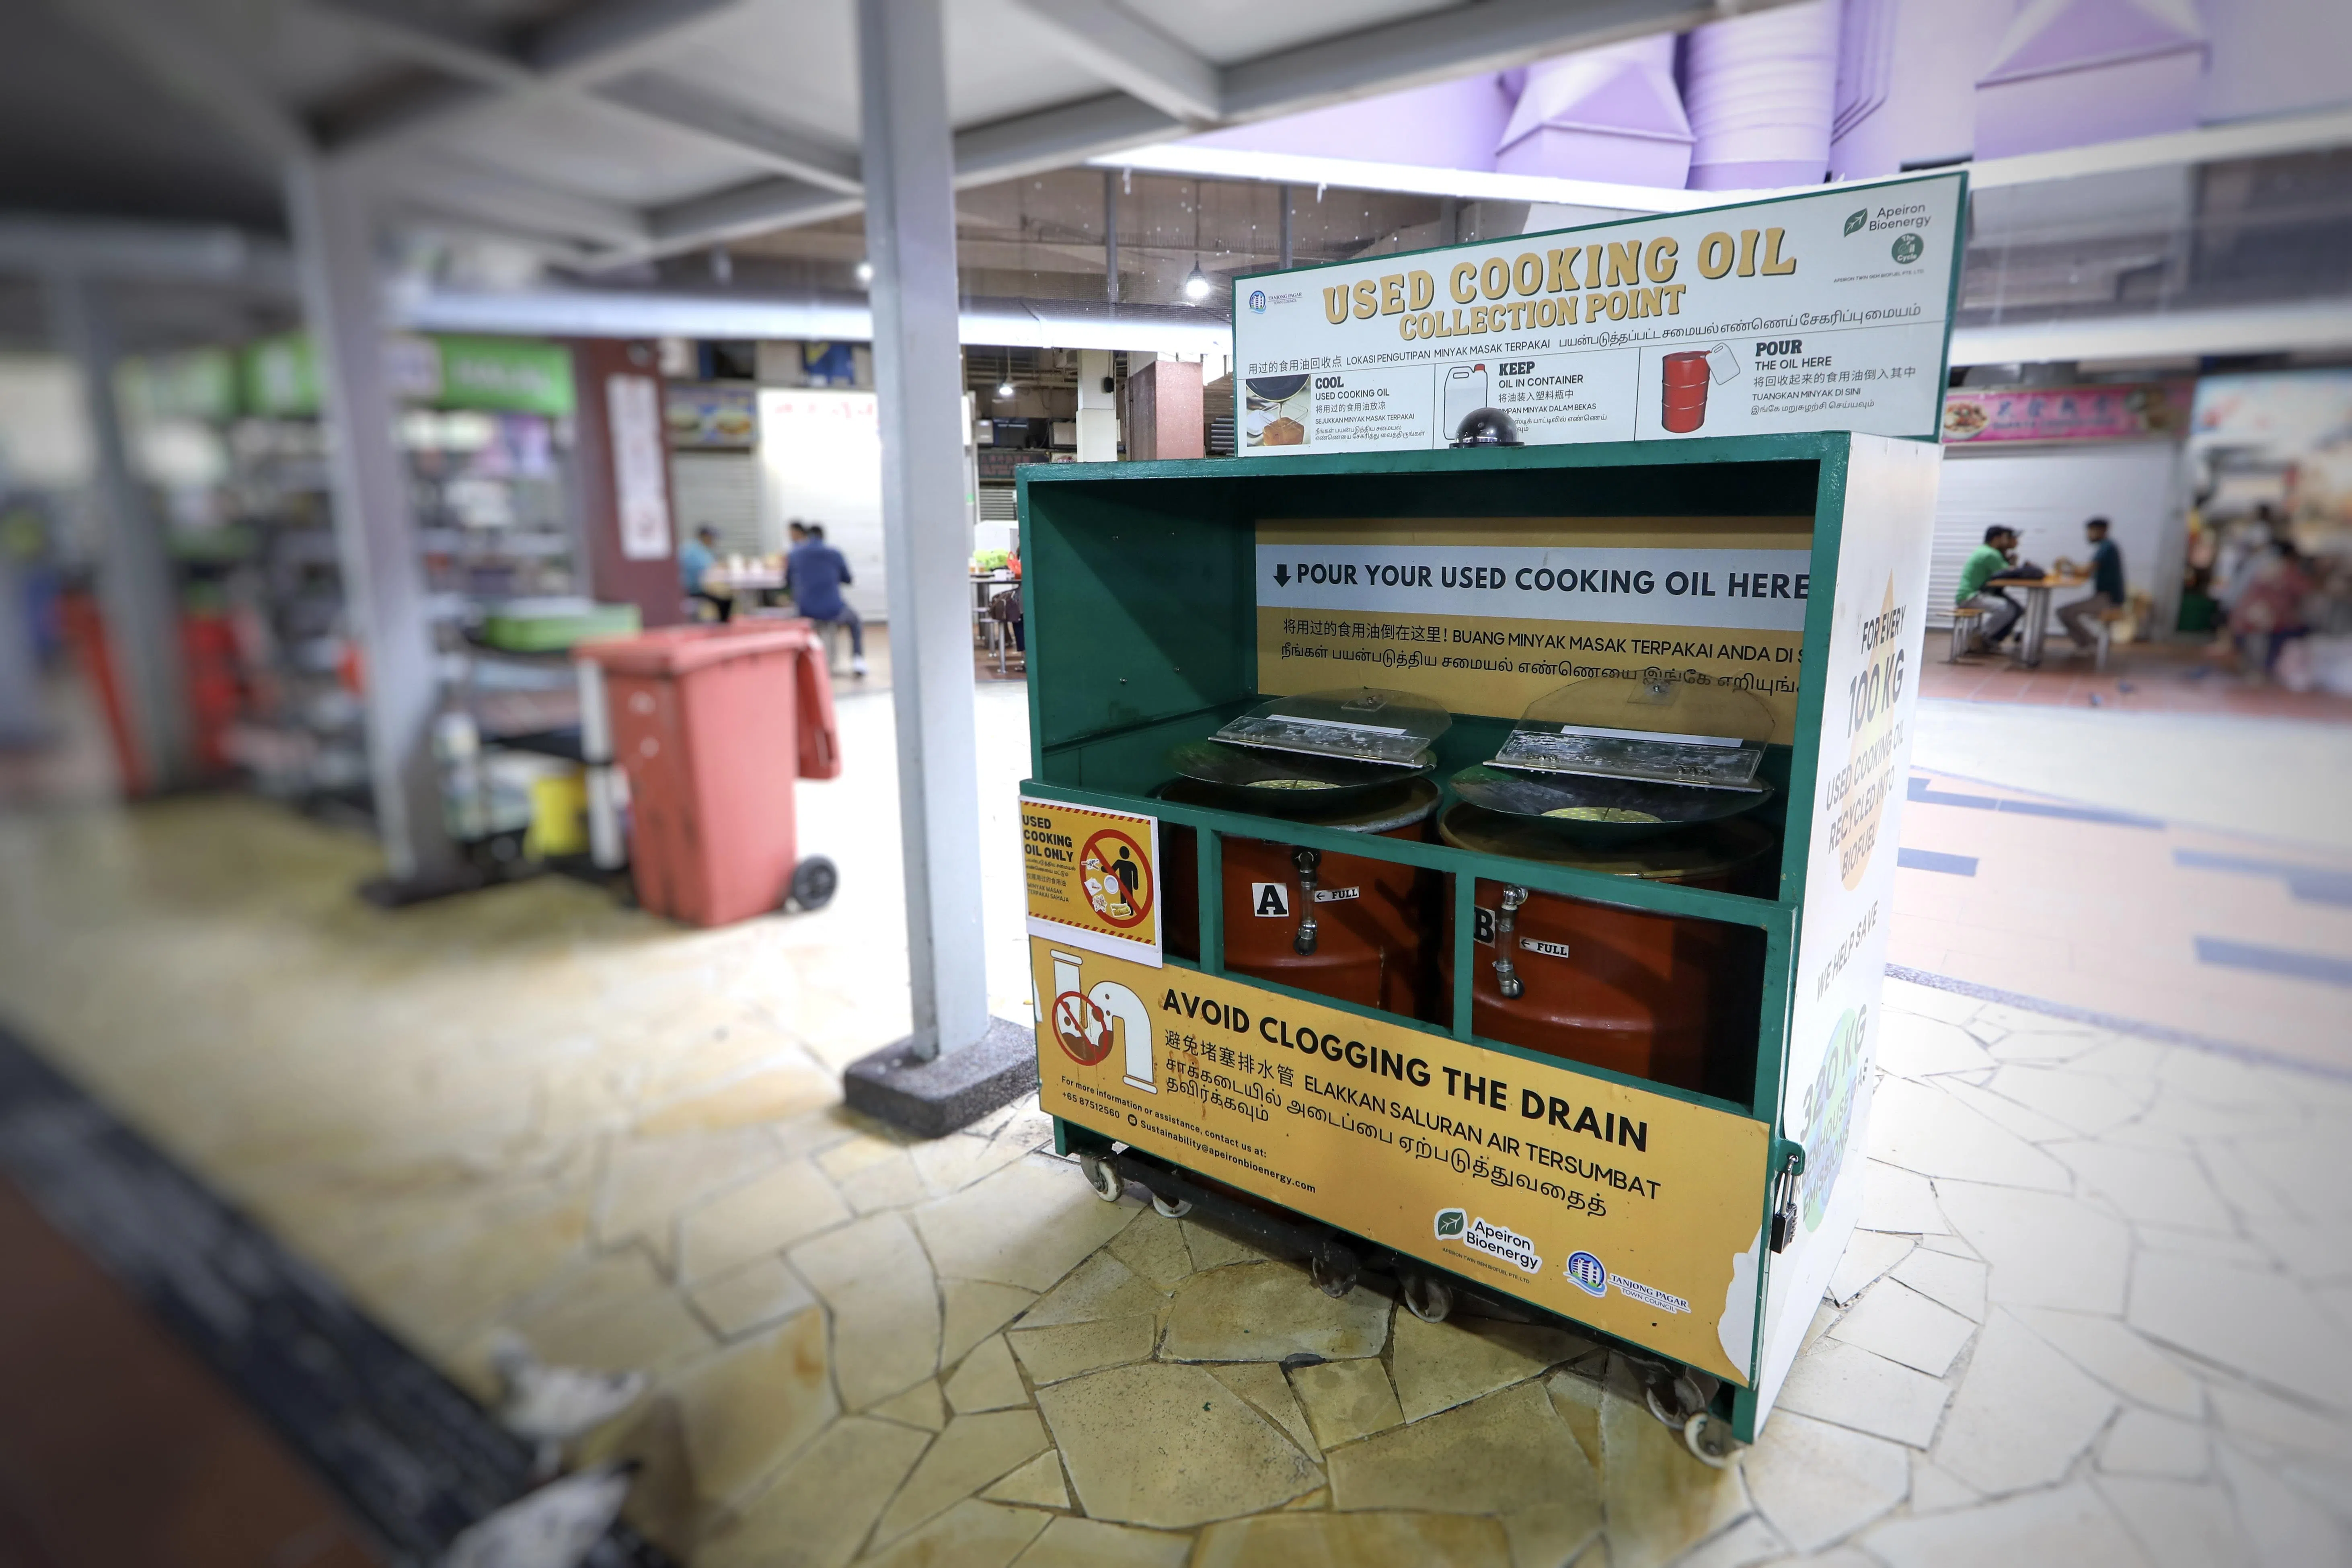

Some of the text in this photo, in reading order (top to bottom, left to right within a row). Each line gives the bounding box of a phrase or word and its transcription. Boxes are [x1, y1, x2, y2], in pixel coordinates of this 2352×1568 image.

[1869, 216, 1931, 231] Bioenergy
[1877, 204, 1925, 219] Apeiron
[1897, 254, 1917, 262] Cycle
[1323, 227, 1797, 325] USED COOKING OIL
[1400, 283, 1686, 341] COLLECTION POINT
[1559, 303, 1921, 347] பயன்படுத்தப்பட்ட சமையல் எண்ணெய் சேகரிப்பு மையம்
[1347, 340, 1550, 365] LOKASI PENGUTIPAN MINYAK MASAK TERPAKAI
[1755, 339, 1802, 356] POUR
[1248, 356, 1342, 375] 用过的食用油回收点
[1499, 361, 1535, 376] KEEP
[1754, 366, 1916, 388] 将回收起来的食用油倒入其中
[1755, 356, 1832, 370] THE OIL HERE
[1315, 376, 1344, 389] COOL
[1316, 388, 1390, 400] USED COOKING OIL
[1499, 375, 1584, 388] OIL IN CONTAINER
[1499, 389, 1574, 403] 将油装入塑料瓶中
[1752, 391, 1799, 401] TUANGKAN
[1801, 389, 1834, 398] MINYAK
[1316, 401, 1386, 413] 将用过的食用油放凉
[1751, 404, 1780, 415] இங்கே
[1335, 425, 1375, 434] பயன்படுத்திய
[1298, 563, 1810, 600] POUR YOUR USED COOKING OIL HERE
[1861, 604, 1906, 655] FOR EVERY
[1453, 630, 1505, 645] BUANG
[1508, 633, 1566, 649] MINYAK
[1569, 636, 1626, 653] MASAK
[1631, 640, 1712, 658] TERPAKAI
[1717, 644, 1770, 662] ANDA
[1775, 647, 1793, 663] DI
[1281, 643, 1328, 660] நீங்கள்
[1333, 647, 1436, 669] பயன்படுத்திய
[1442, 654, 1513, 672] சமையல்
[1718, 671, 1799, 696] எறியுங்
[1847, 648, 1904, 739] 100 KG
[1826, 719, 1904, 811] USED COOKING OIL
[1023, 815, 1051, 829] USED
[1828, 764, 1895, 855] RECYCLED INTO
[1024, 830, 1072, 848] COOKING
[1025, 844, 1074, 862] OIL ONLY
[1841, 821, 1876, 882] BIOFUEL
[1046, 886, 1062, 894] MASAK
[1050, 894, 1069, 902] SAHAJA
[1257, 885, 1287, 914] A
[1332, 889, 1358, 899] FULL
[1474, 907, 1494, 943] B
[1537, 942, 1567, 956] FULL
[1817, 899, 1878, 1003] WE HELP SAVE
[1163, 989, 1647, 1153] AVOID CLOGGING THE DRAIN
[1165, 1030, 1294, 1088] 避免堵塞排水管
[1800, 1004, 1867, 1143] 320 KG
[1851, 1057, 1868, 1102] GAS
[1166, 1076, 1269, 1123] தவிர்க்கவும்
[1062, 1076, 1267, 1158] For more information or assistance, contact us at:
[1062, 1091, 1316, 1194] +65 87512560 Sustainability@apeironbioenergy.com
[1166, 1058, 1606, 1217] சாக்கடையில் அடைப்பை ஏற்படுத்துவதைத்
[1305, 1075, 1661, 1200] ELAKKAN SALURAN AIR TERSUMBAT
[1803, 1119, 1850, 1224] EMISSIONS
[1475, 1221, 1530, 1250] Apeiron
[1442, 1247, 1463, 1258] APEIRON
[1463, 1255, 1476, 1263] TWIN
[1488, 1264, 1508, 1276] BIOFUEL
[1466, 1231, 1539, 1270] Bioenergy
[1610, 1274, 1687, 1308] TANJONG PAGAR
[1622, 1287, 1675, 1312] TOWN COUNCIL
